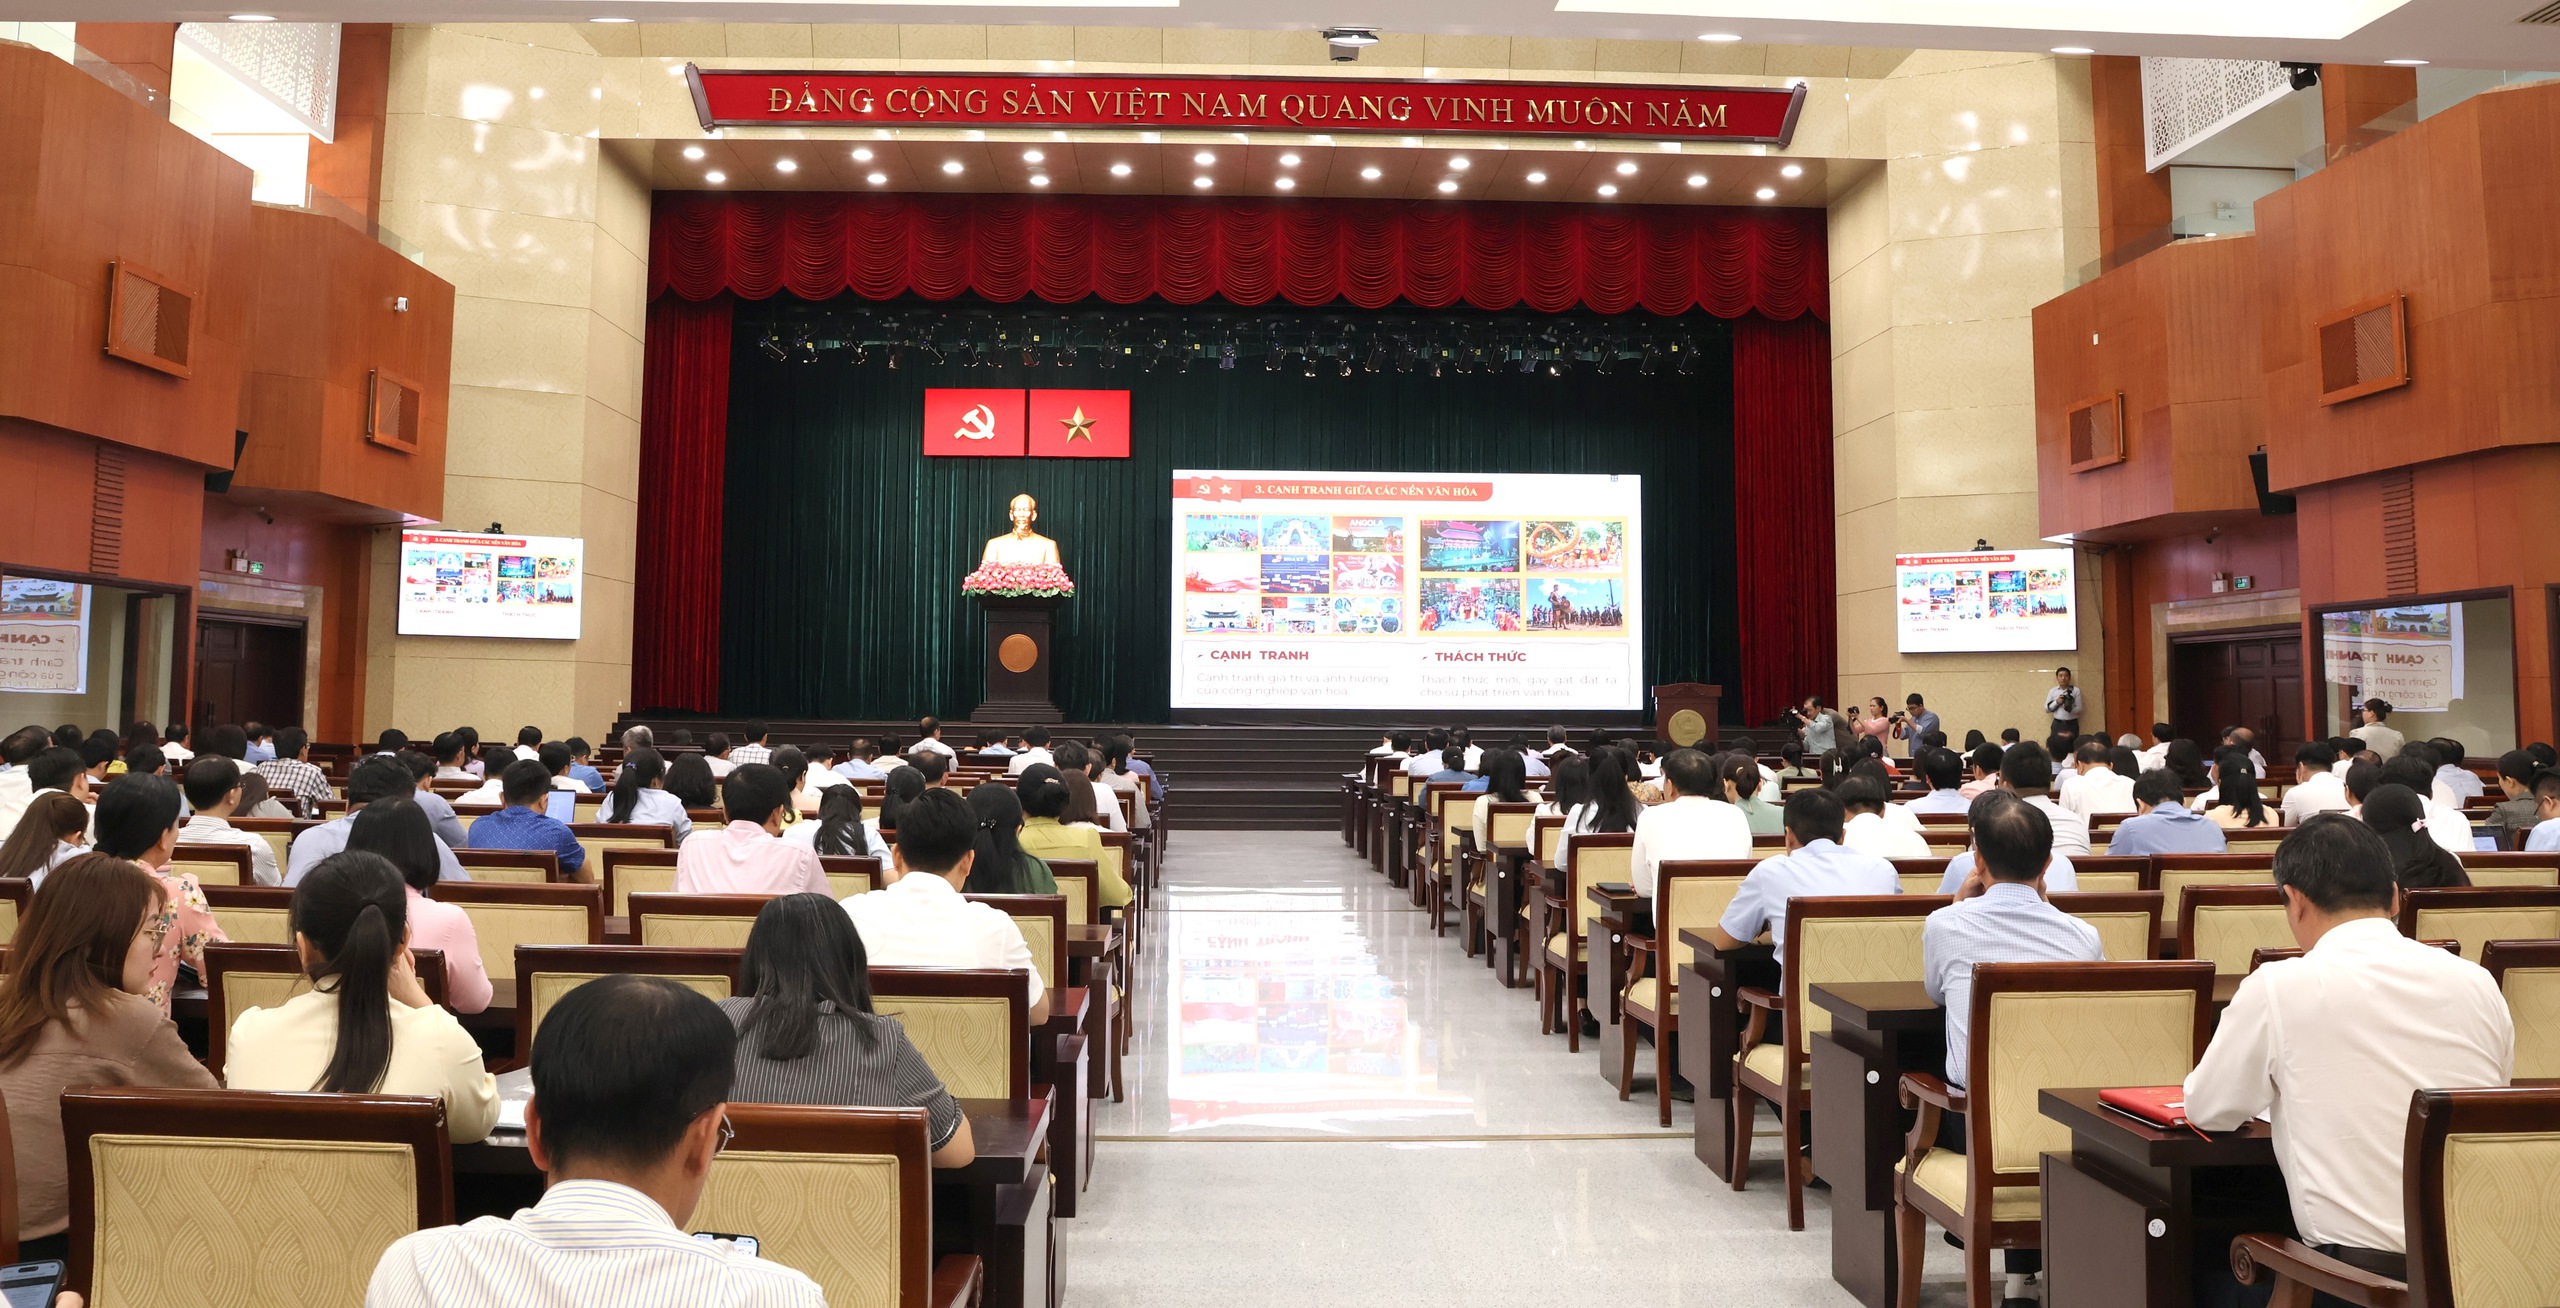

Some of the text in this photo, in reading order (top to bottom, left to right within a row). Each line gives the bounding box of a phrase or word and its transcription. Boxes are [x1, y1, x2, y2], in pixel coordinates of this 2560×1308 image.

[768, 81, 1728, 128] ĐẢNG CỘNG SẢN VIỆT NAM QUANG VINH MUÔN NĂM
[1255, 485, 1265, 494] 3.
[1268, 485, 1300, 495] CẠNH
[1302, 486, 1342, 495] TRANH
[1344, 484, 1372, 495] GIỮA
[1375, 485, 1398, 496] CÁC
[1426, 486, 1450, 496] VĂN
[1453, 486, 1478, 496] HÓA
[1350, 519, 1384, 527] ANGOLA
[1210, 650, 1309, 662] CẠNH TRANH
[1435, 650, 1526, 662] THÁCH THỨC
[1232, 673, 1264, 682] tranh
[1420, 688, 1442, 696] cho
